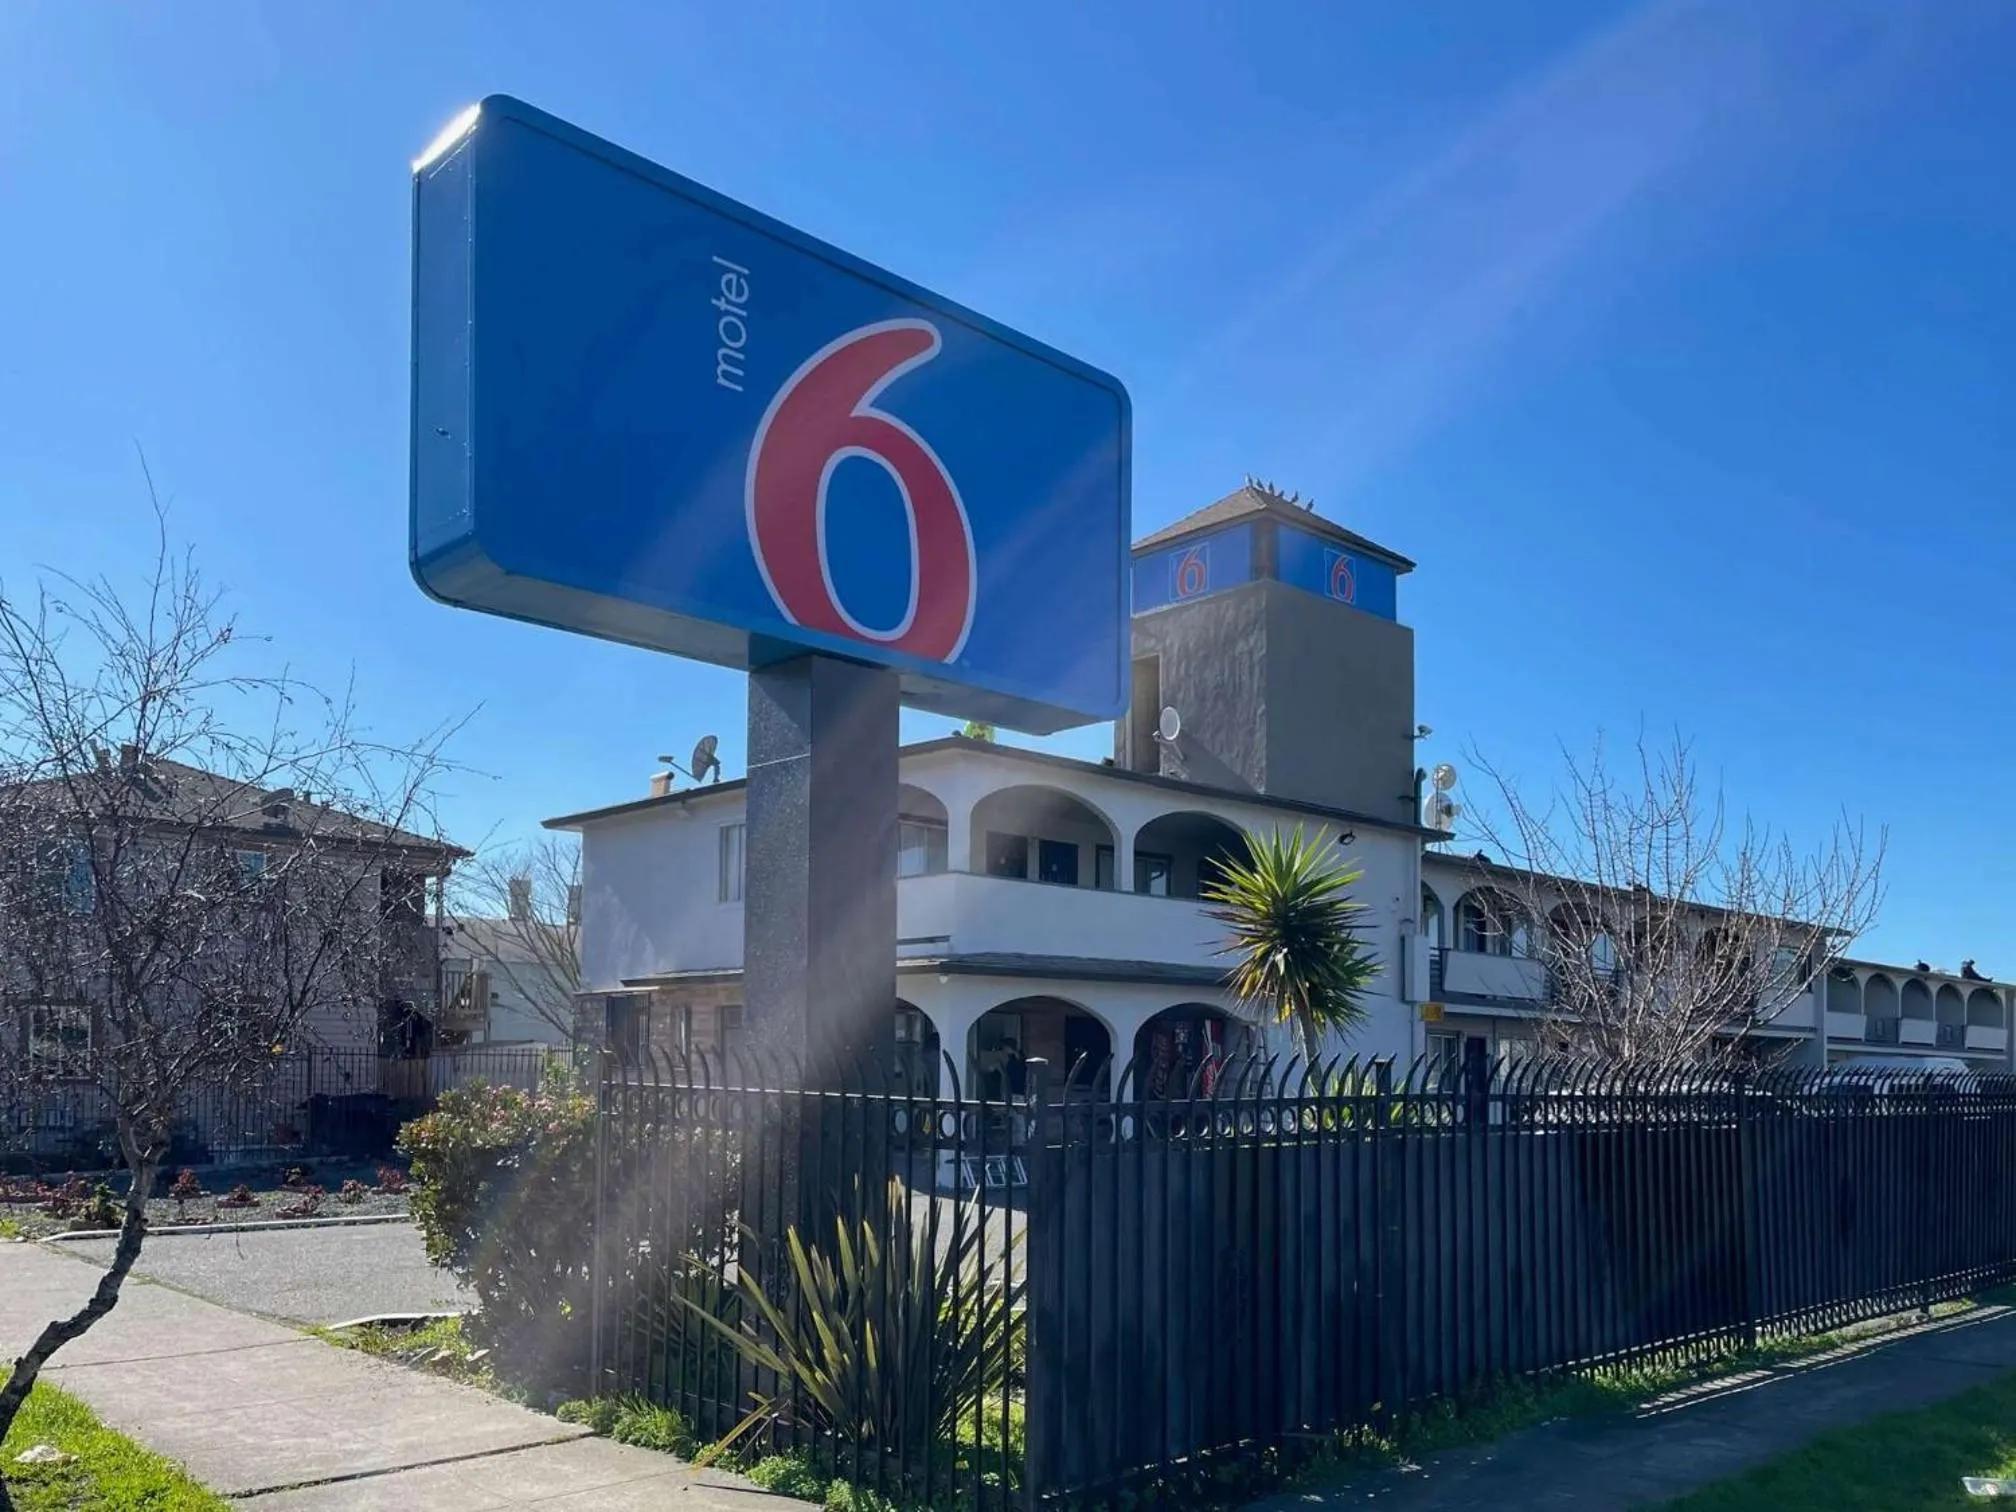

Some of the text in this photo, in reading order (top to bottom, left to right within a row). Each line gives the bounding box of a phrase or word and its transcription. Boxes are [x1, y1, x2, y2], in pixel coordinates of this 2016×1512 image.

[711, 255, 750, 392] motel
[744, 317, 977, 665] 6
[1177, 546, 1206, 599] 6
[1331, 554, 1354, 602] 6
